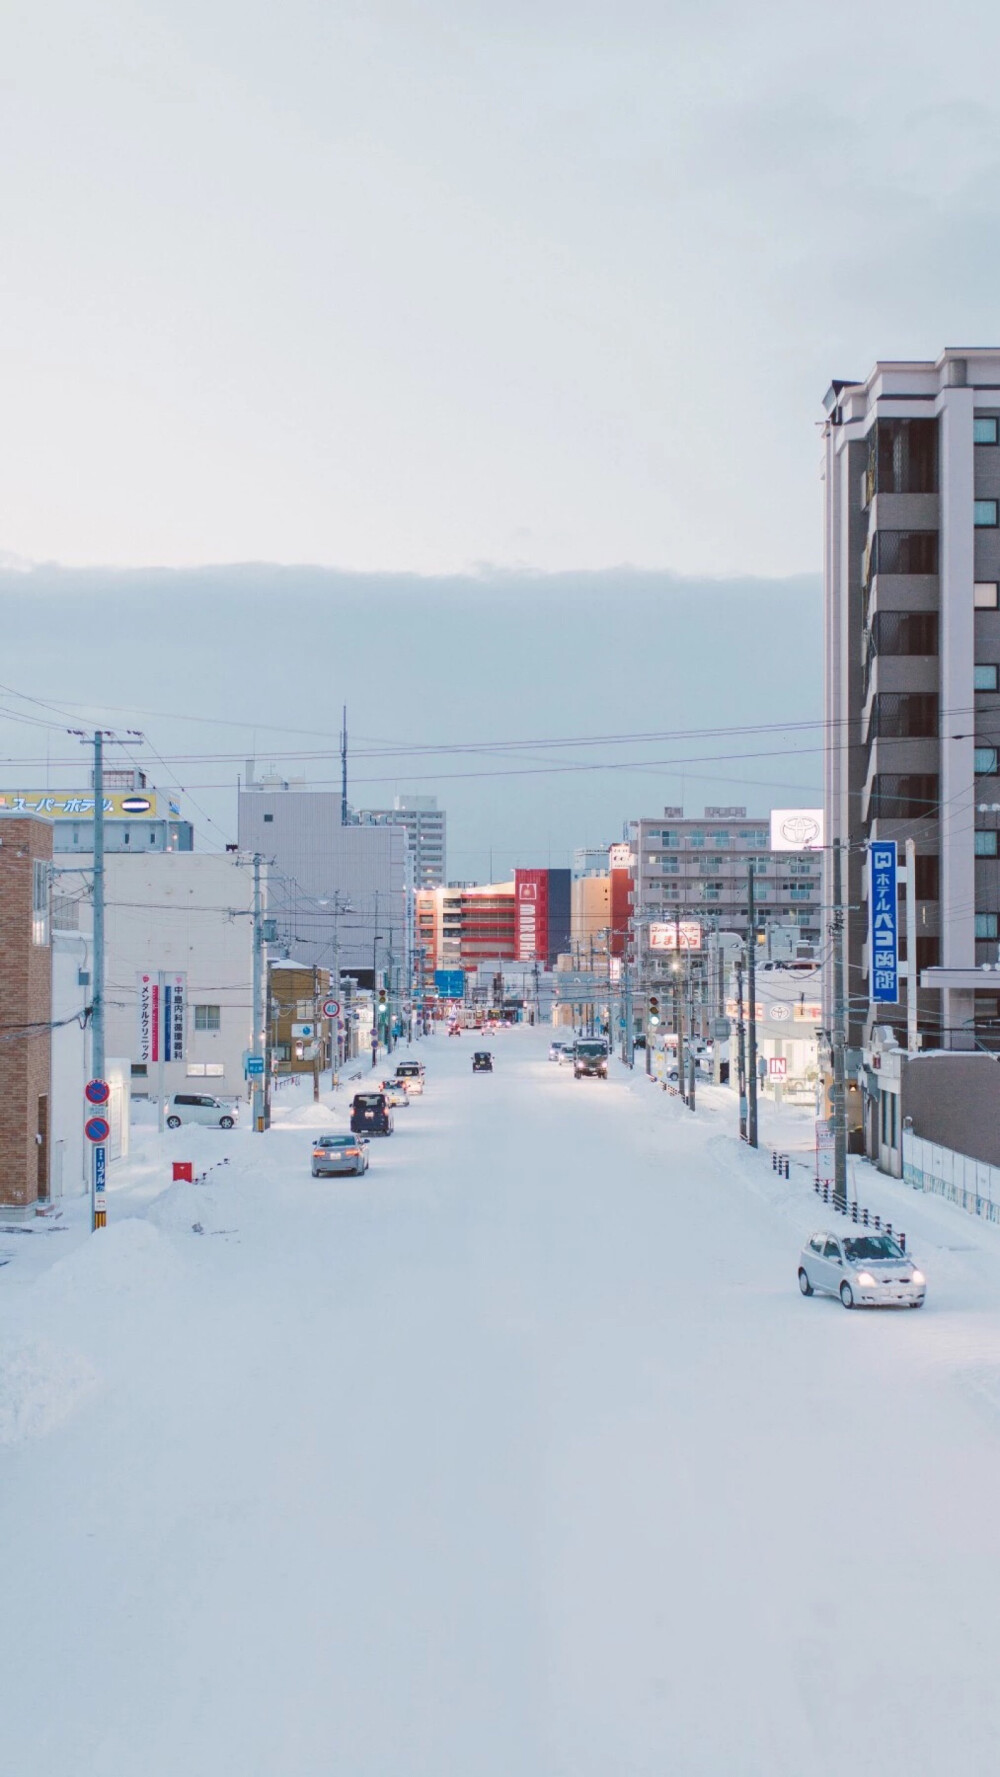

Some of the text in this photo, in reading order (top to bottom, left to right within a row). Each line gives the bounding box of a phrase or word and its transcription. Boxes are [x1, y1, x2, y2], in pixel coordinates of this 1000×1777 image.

[327, 1004, 337, 1013] 40
[141, 986, 150, 1061] メンタルクリニック
[771, 1059, 786, 1073] IN
